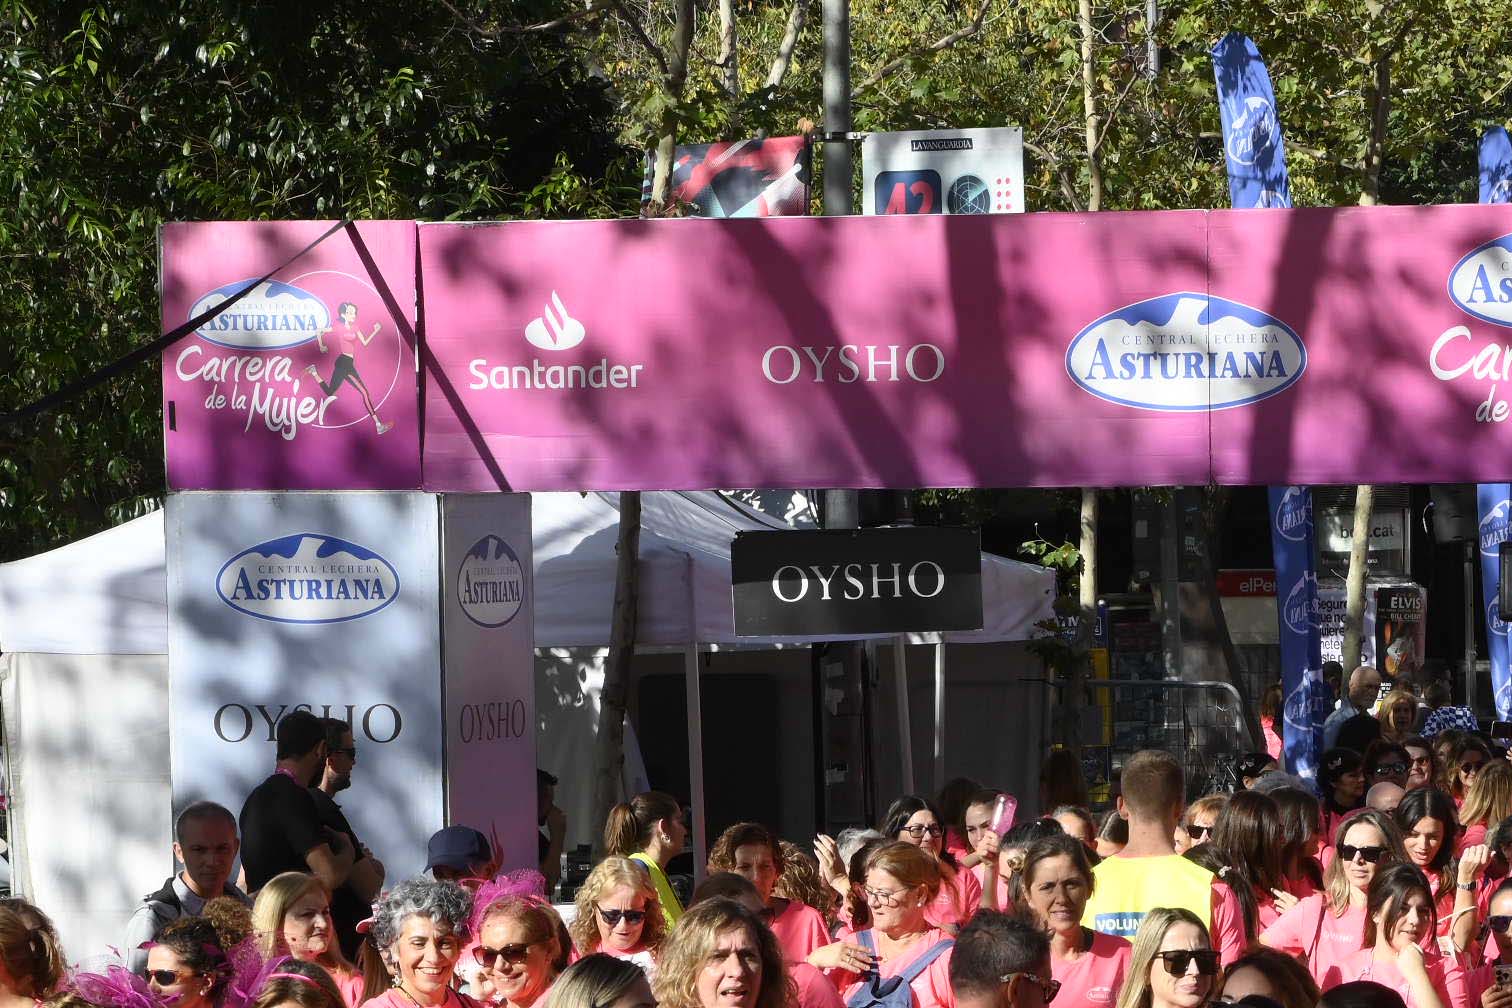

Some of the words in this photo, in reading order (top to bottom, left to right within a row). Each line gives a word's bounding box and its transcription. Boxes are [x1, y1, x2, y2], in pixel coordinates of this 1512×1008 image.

[1121, 334, 1199, 345] CENTRAL
[175, 345, 295, 382] Carrera
[469, 358, 643, 390] Santander
[762, 343, 945, 385] OYSHO
[1086, 336, 1288, 380] ASTURIANA
[204, 390, 227, 411] de
[231, 389, 248, 410] la
[246, 381, 338, 440] Mujer
[1476, 384, 1510, 424] de
[231, 567, 387, 601] ASTURIANA
[258, 564, 317, 574] CENTRAL
[322, 564, 380, 574] LECHERA
[463, 569, 521, 605] ASTURIANA
[771, 560, 945, 602] OYSHO
[1390, 596, 1421, 609] ELVIS
[460, 699, 527, 744] OYSHO
[1096, 917, 1142, 932] VOLUN
